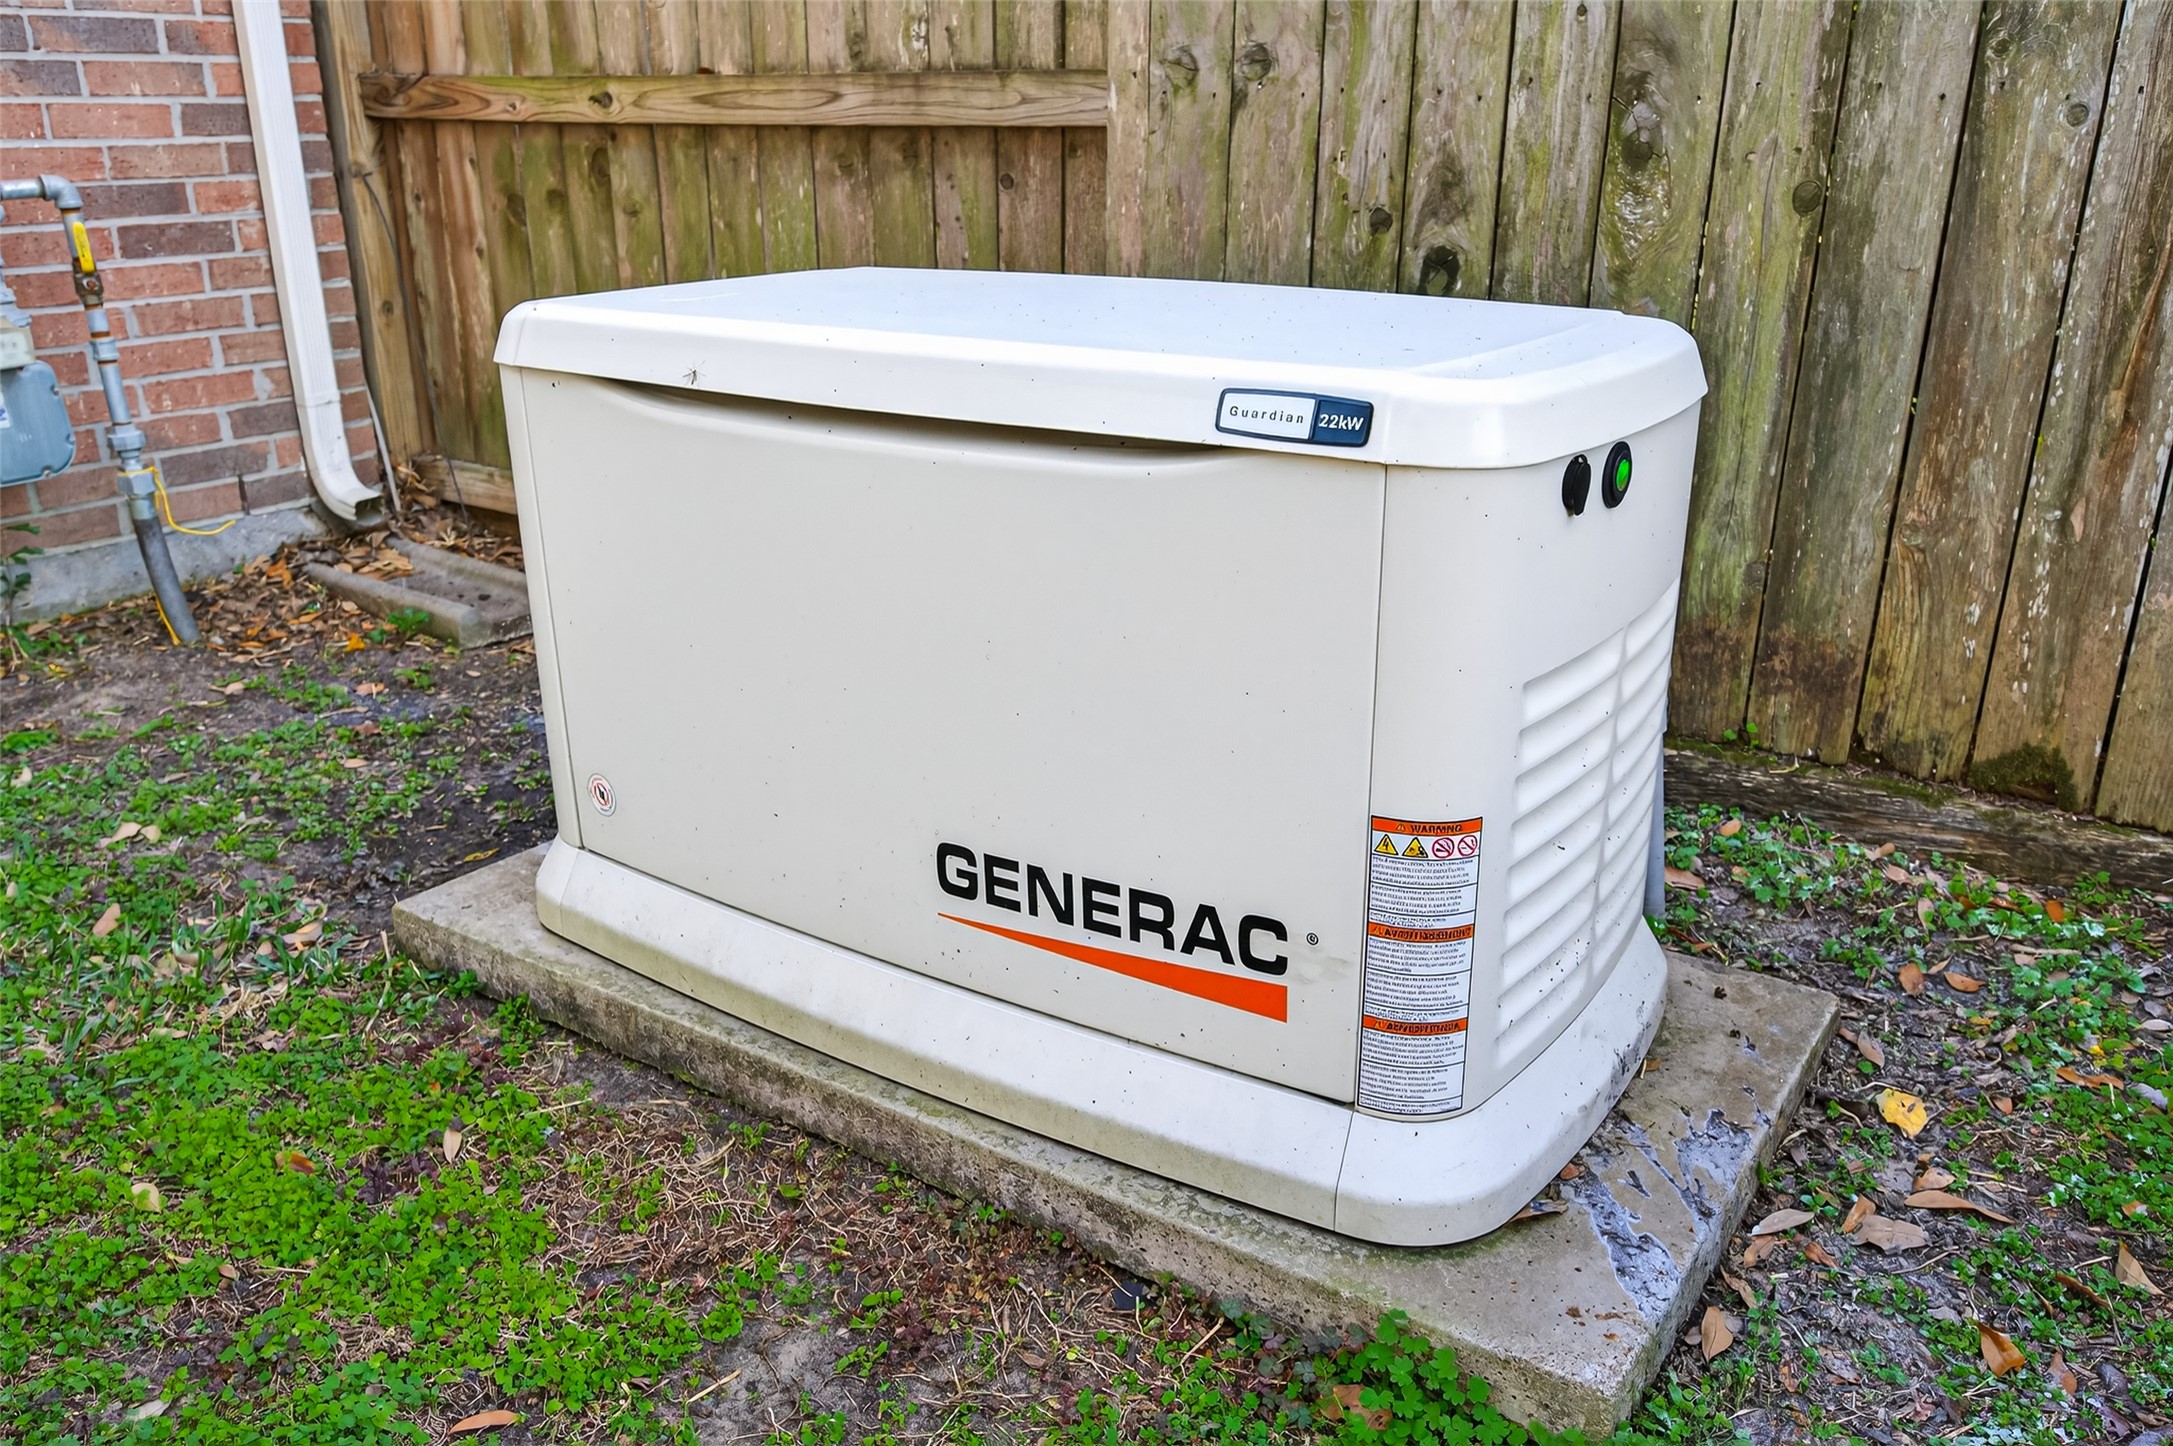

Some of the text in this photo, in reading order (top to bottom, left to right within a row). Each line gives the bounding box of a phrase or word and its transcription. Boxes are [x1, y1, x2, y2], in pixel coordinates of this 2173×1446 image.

[1229, 405, 1364, 431] Guardian 22kW
[936, 841, 1288, 976] GENERAC
